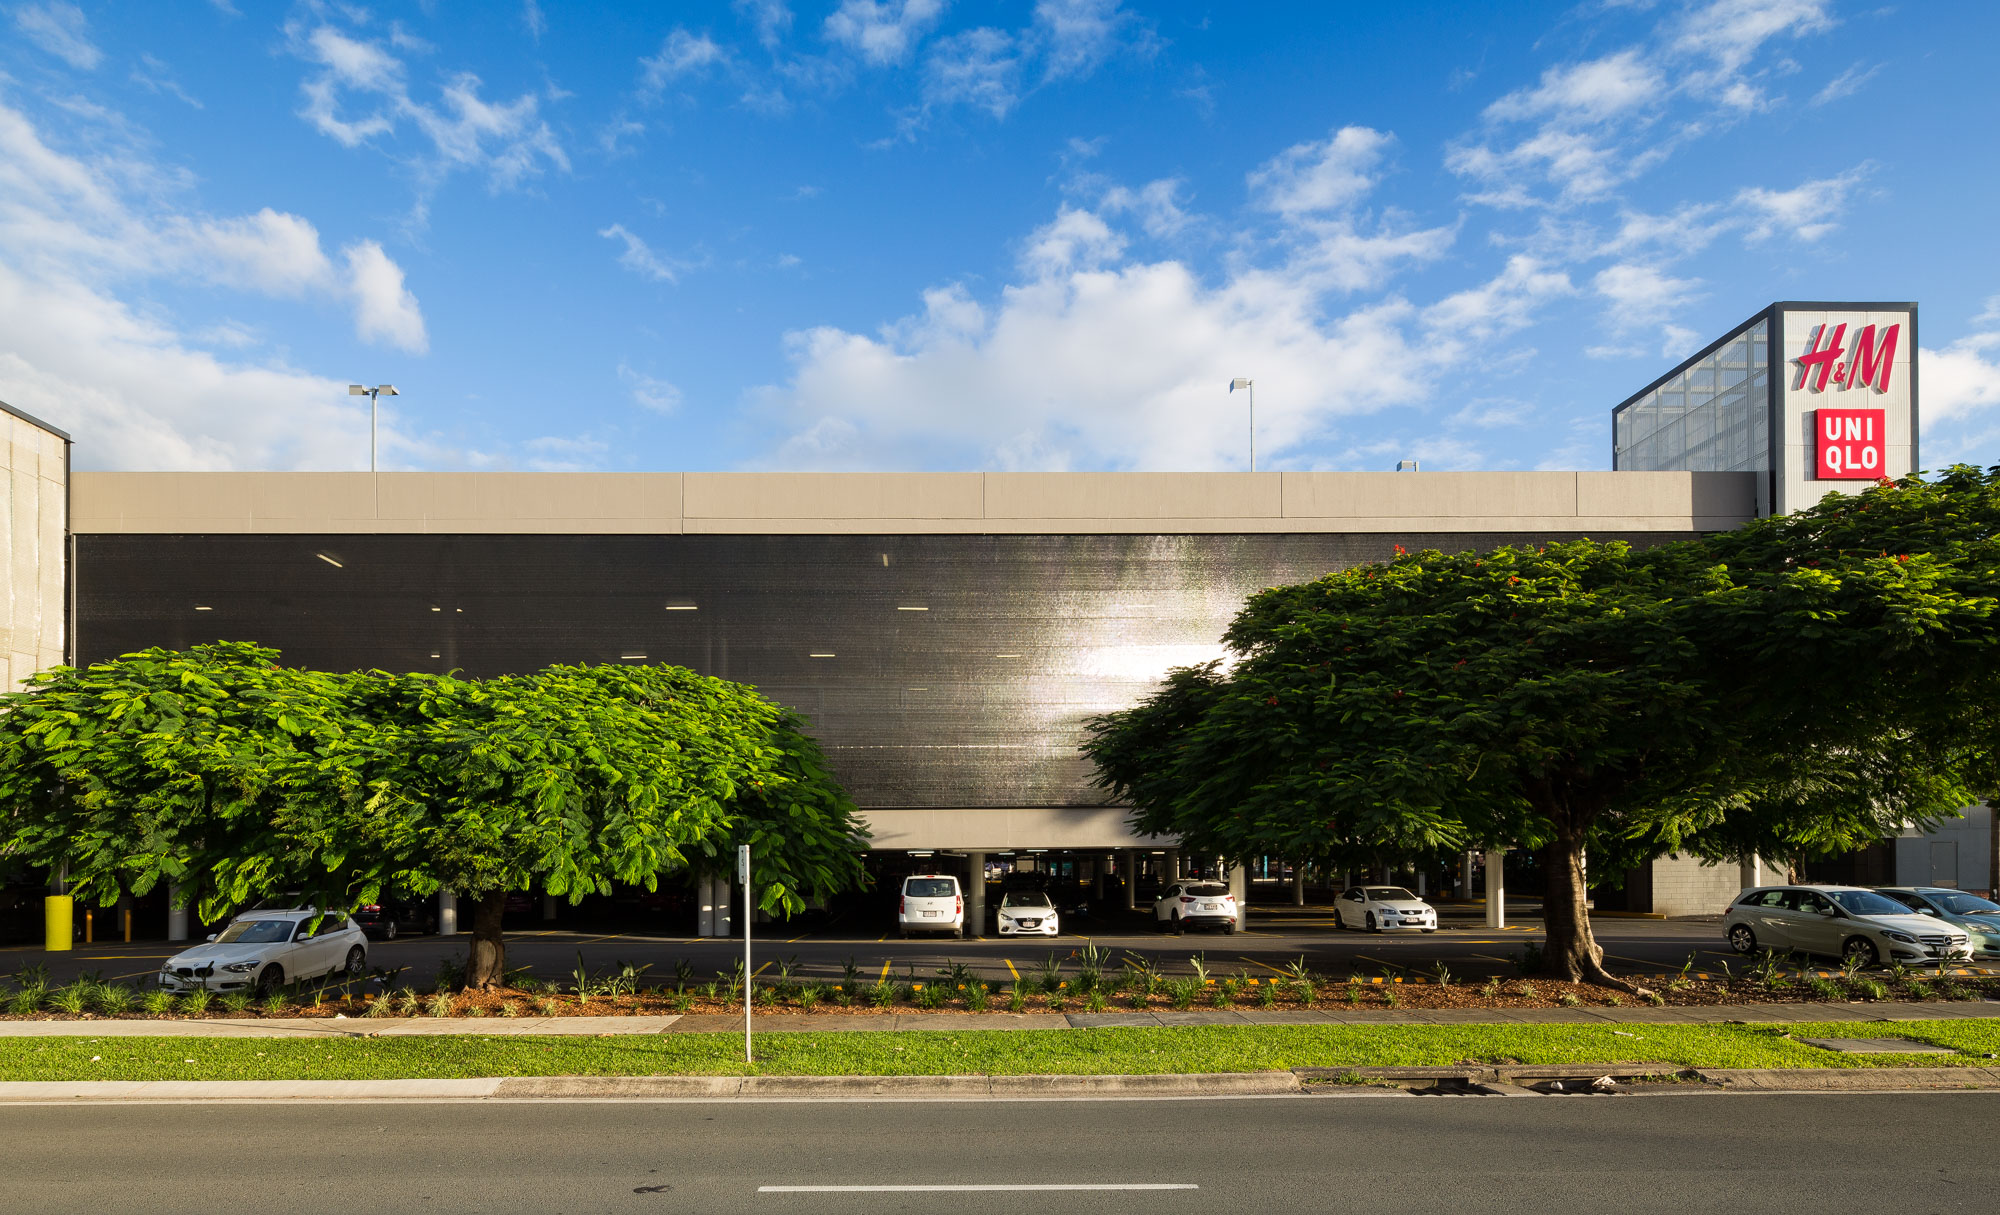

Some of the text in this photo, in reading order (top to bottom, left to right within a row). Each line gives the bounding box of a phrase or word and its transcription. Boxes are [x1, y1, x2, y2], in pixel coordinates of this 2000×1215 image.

[1798, 322, 1900, 393] H&M
[1825, 417, 1873, 441] UNI
[1825, 445, 1878, 474] QLO
